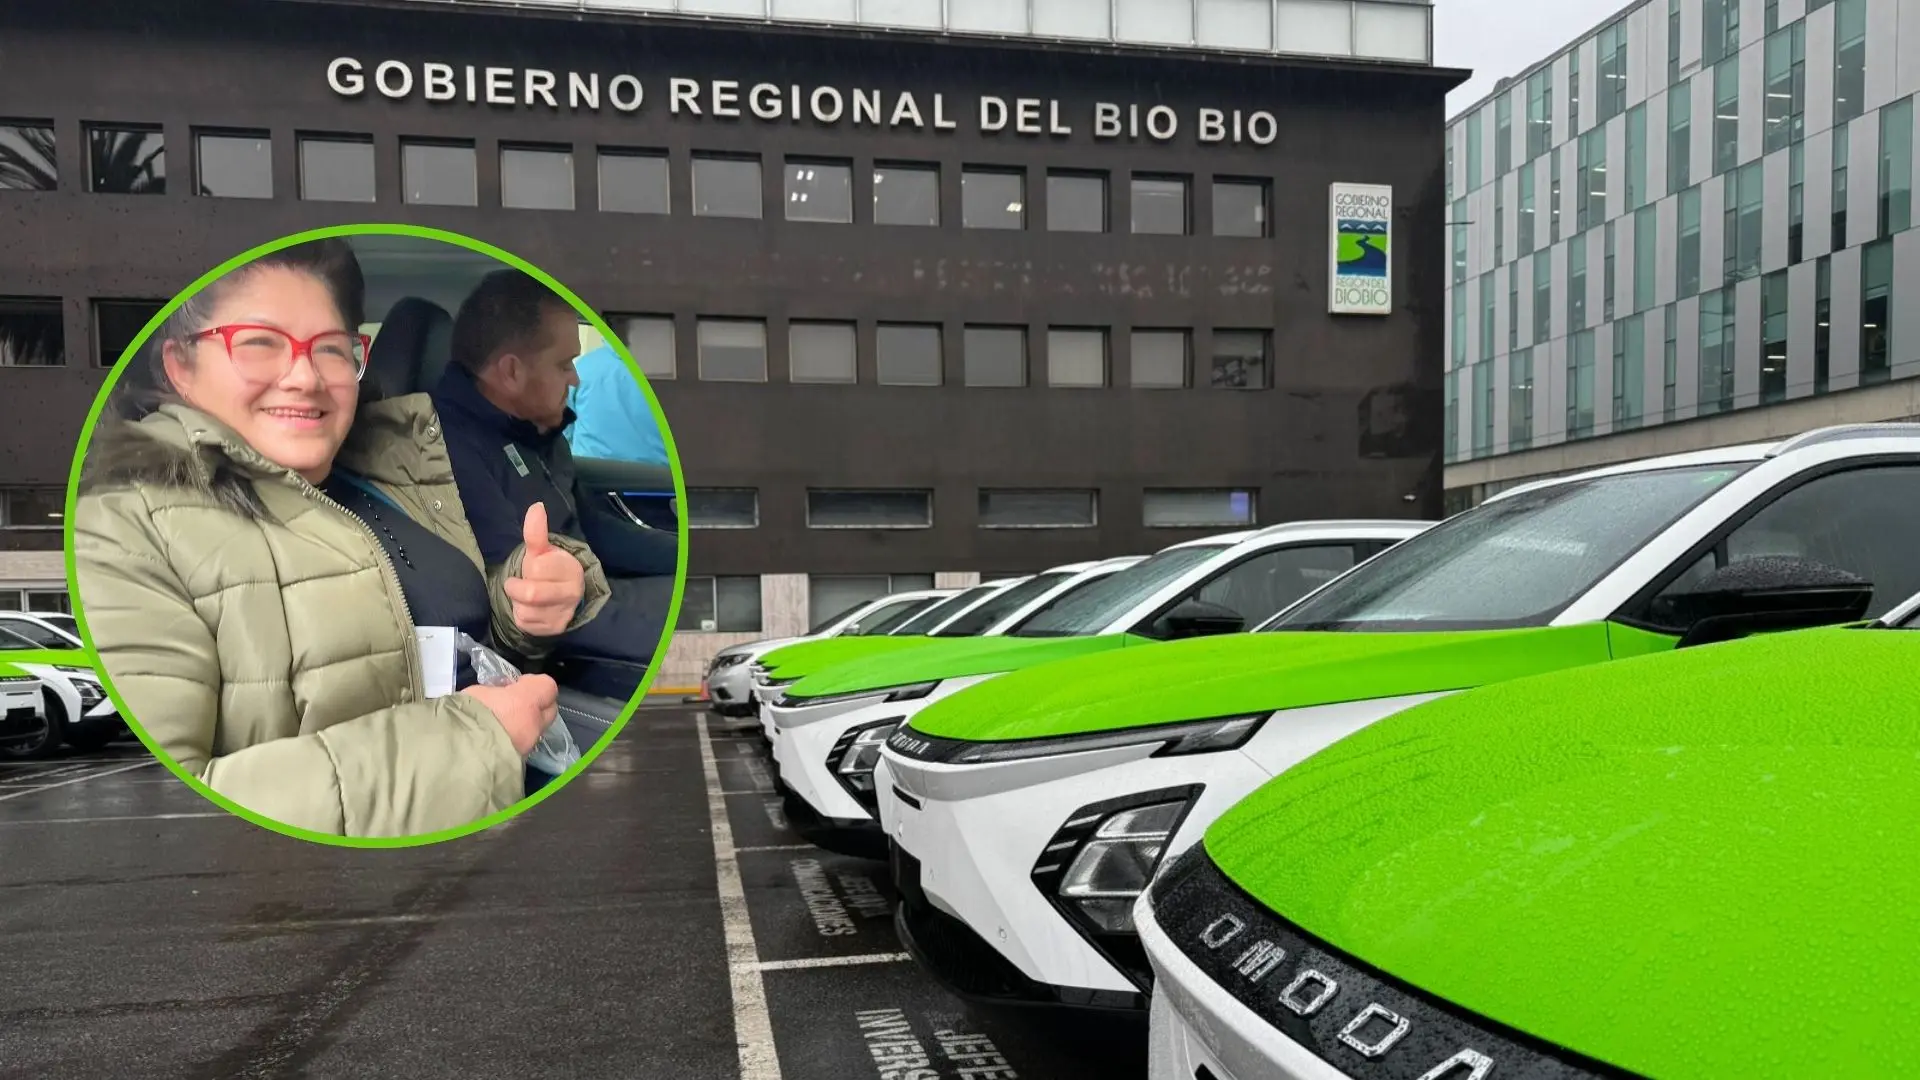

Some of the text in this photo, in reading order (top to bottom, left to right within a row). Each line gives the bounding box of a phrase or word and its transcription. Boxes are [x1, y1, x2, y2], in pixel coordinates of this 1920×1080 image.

[327, 57, 1278, 145] GOBIERNO REGIONAL DEL BIO BIO
[1335, 193, 1389, 207] GOBIERNO
[1335, 205, 1388, 219] REGIONAL
